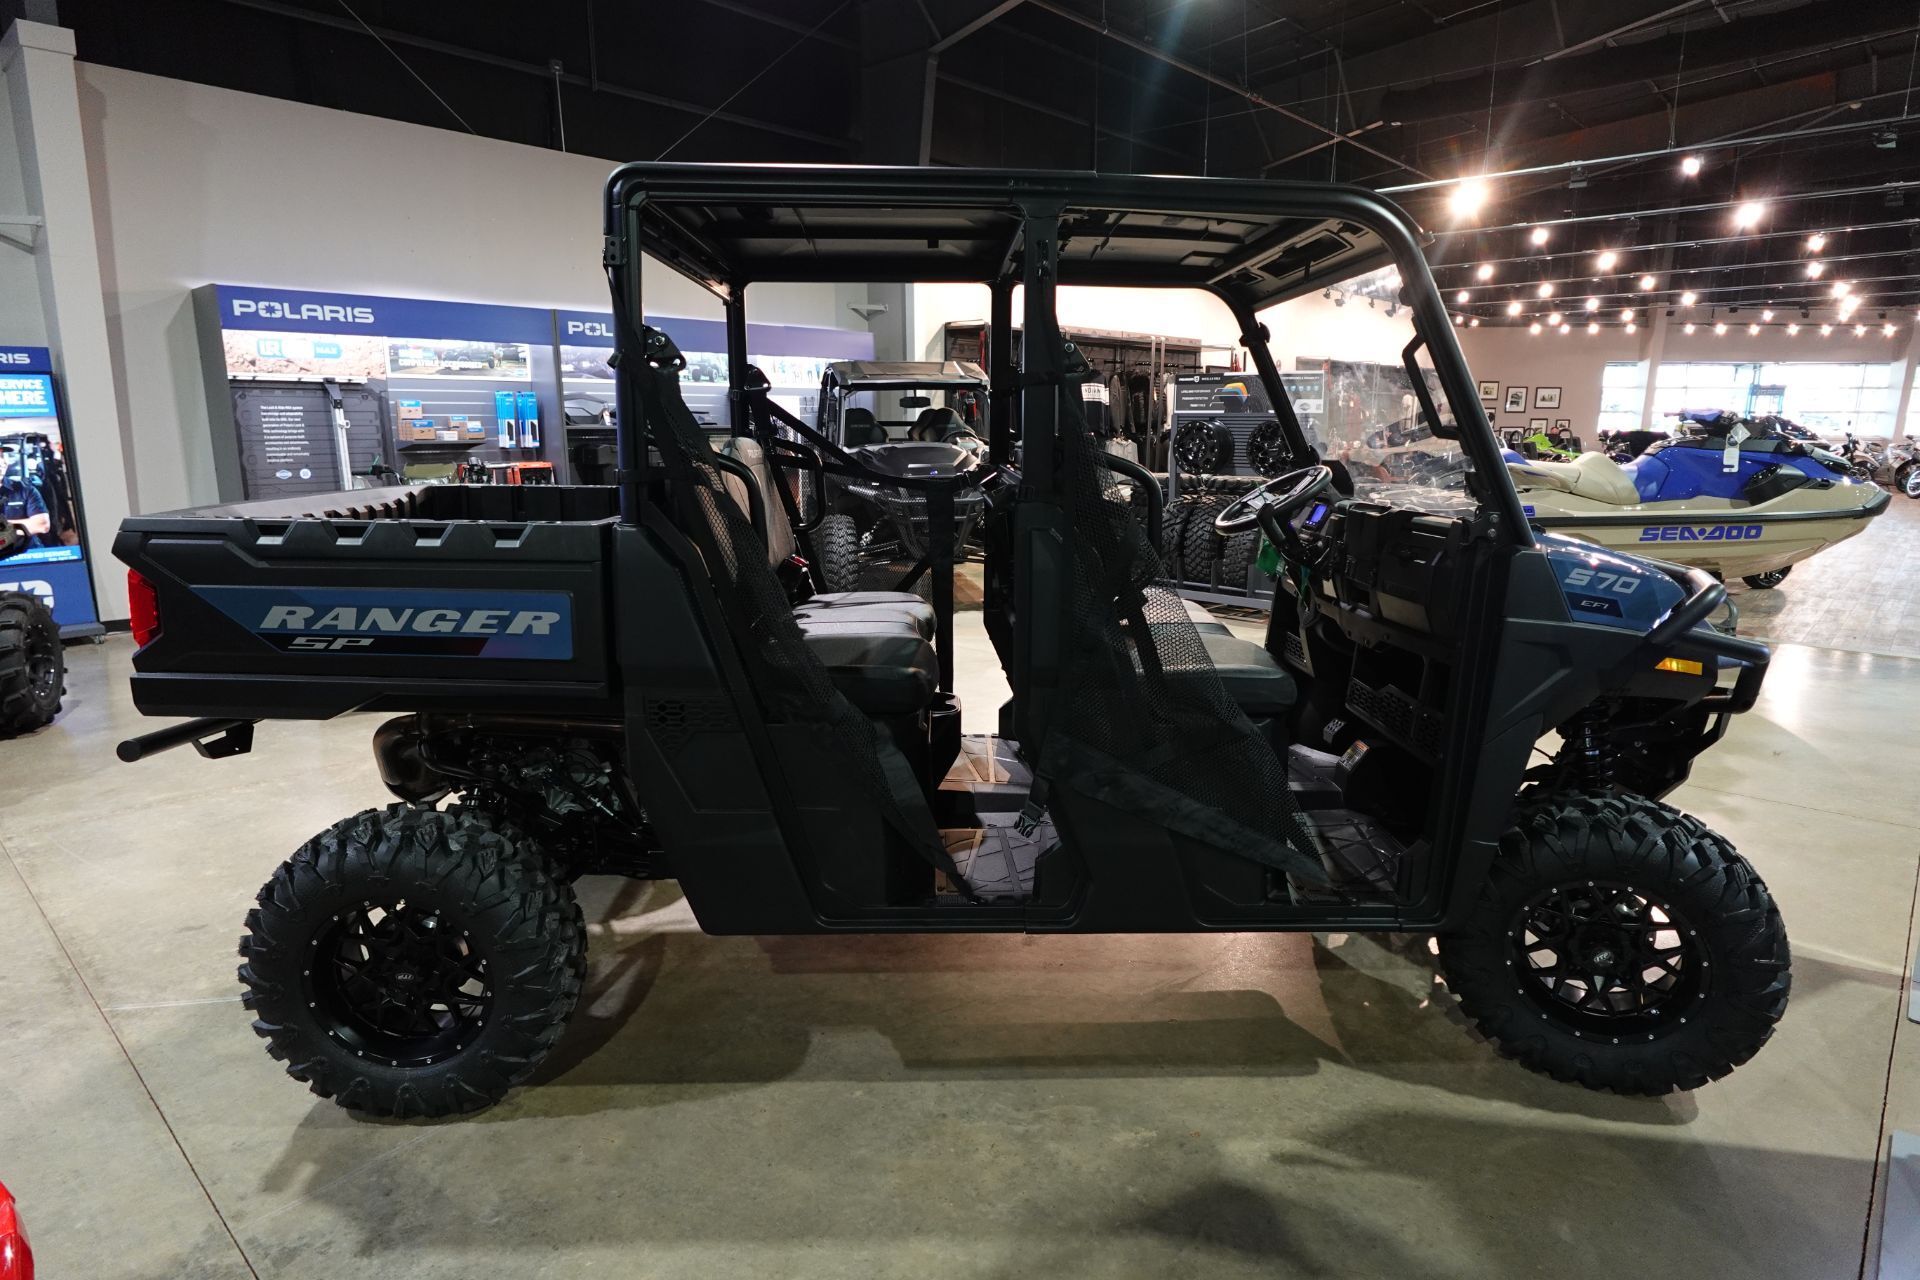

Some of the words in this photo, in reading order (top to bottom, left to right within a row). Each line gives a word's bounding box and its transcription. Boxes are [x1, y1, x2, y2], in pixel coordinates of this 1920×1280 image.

[232, 299, 375, 324] POLARIS
[0, 378, 44, 390] ERVICE
[1564, 567, 1640, 594] 570
[1580, 600, 1609, 610] EFI
[259, 605, 561, 635] RANGER
[287, 636, 376, 650] SP
